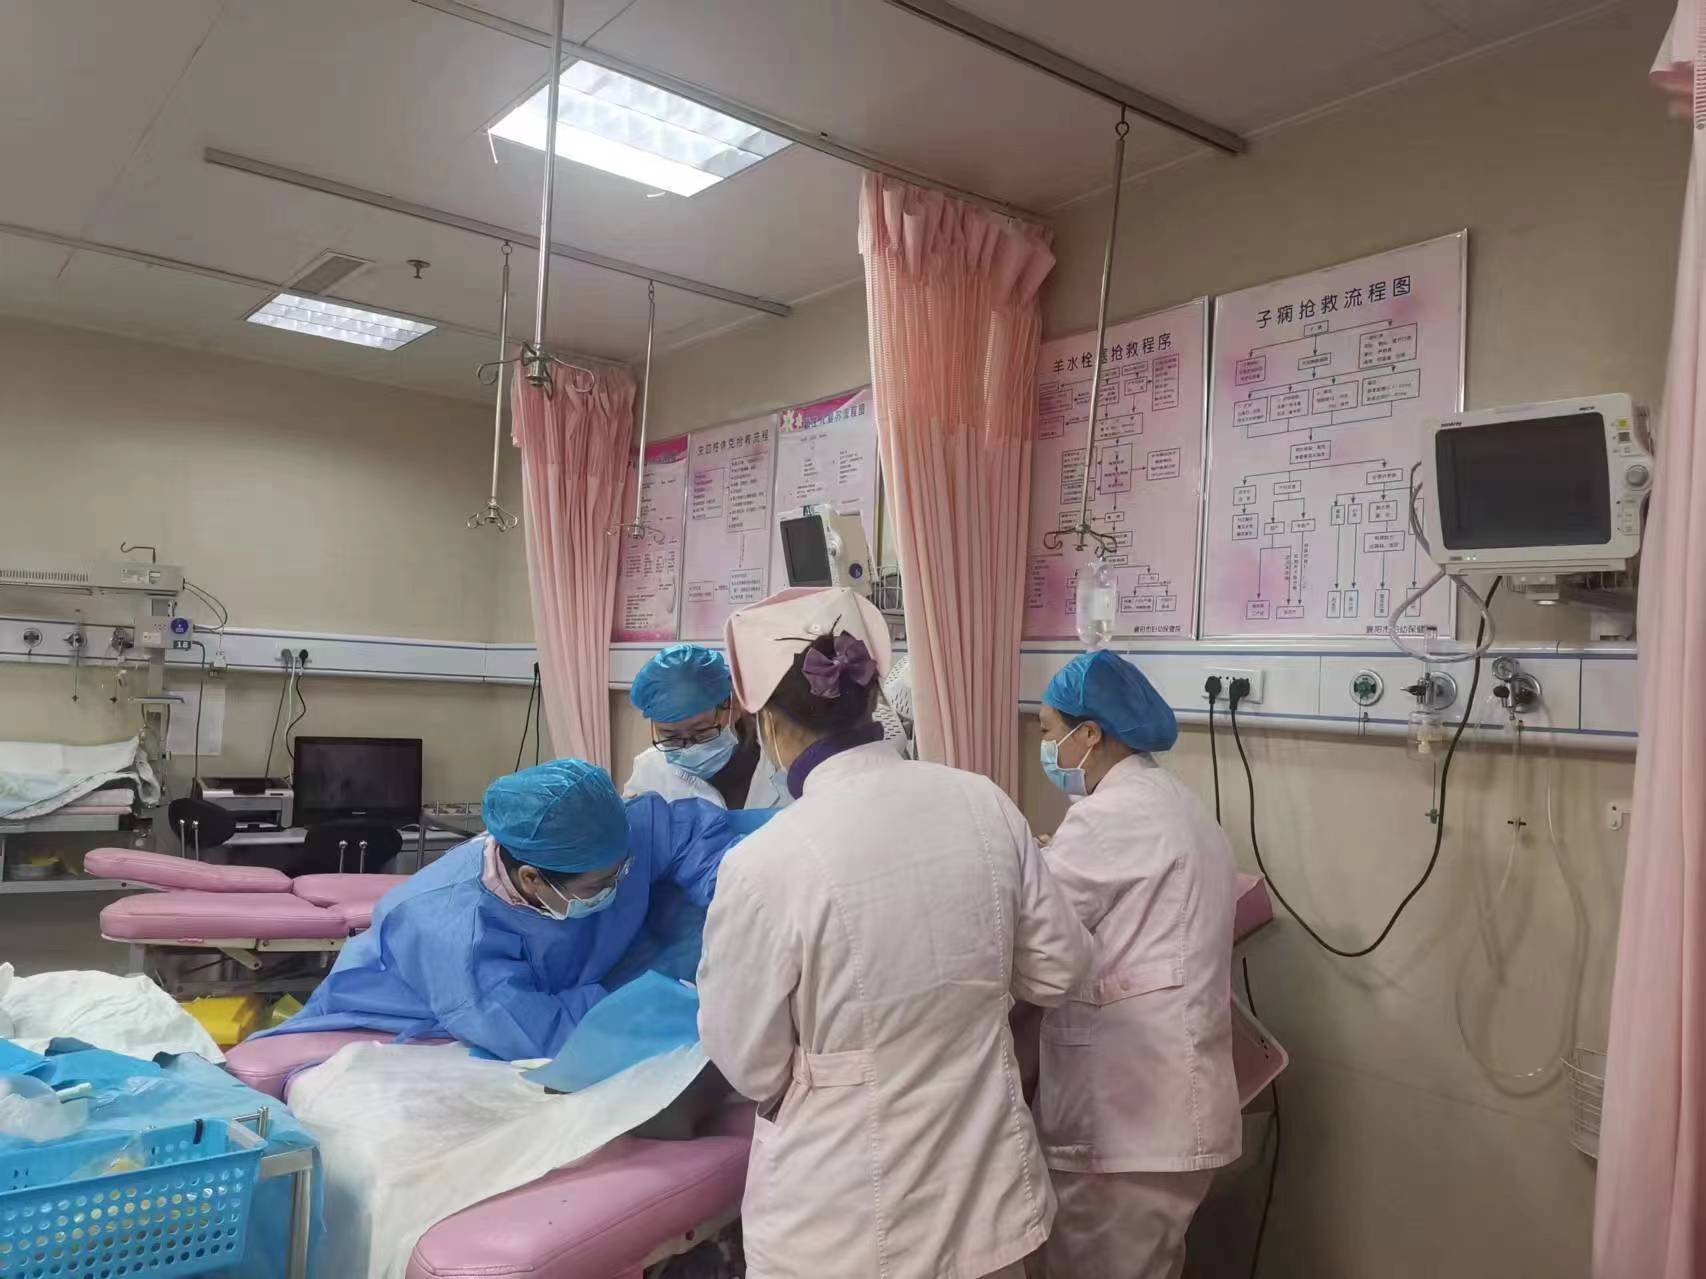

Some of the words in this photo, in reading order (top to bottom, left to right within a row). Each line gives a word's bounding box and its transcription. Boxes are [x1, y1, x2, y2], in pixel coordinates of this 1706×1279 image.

[1256, 275, 1412, 329] 子痫抢救流程图
